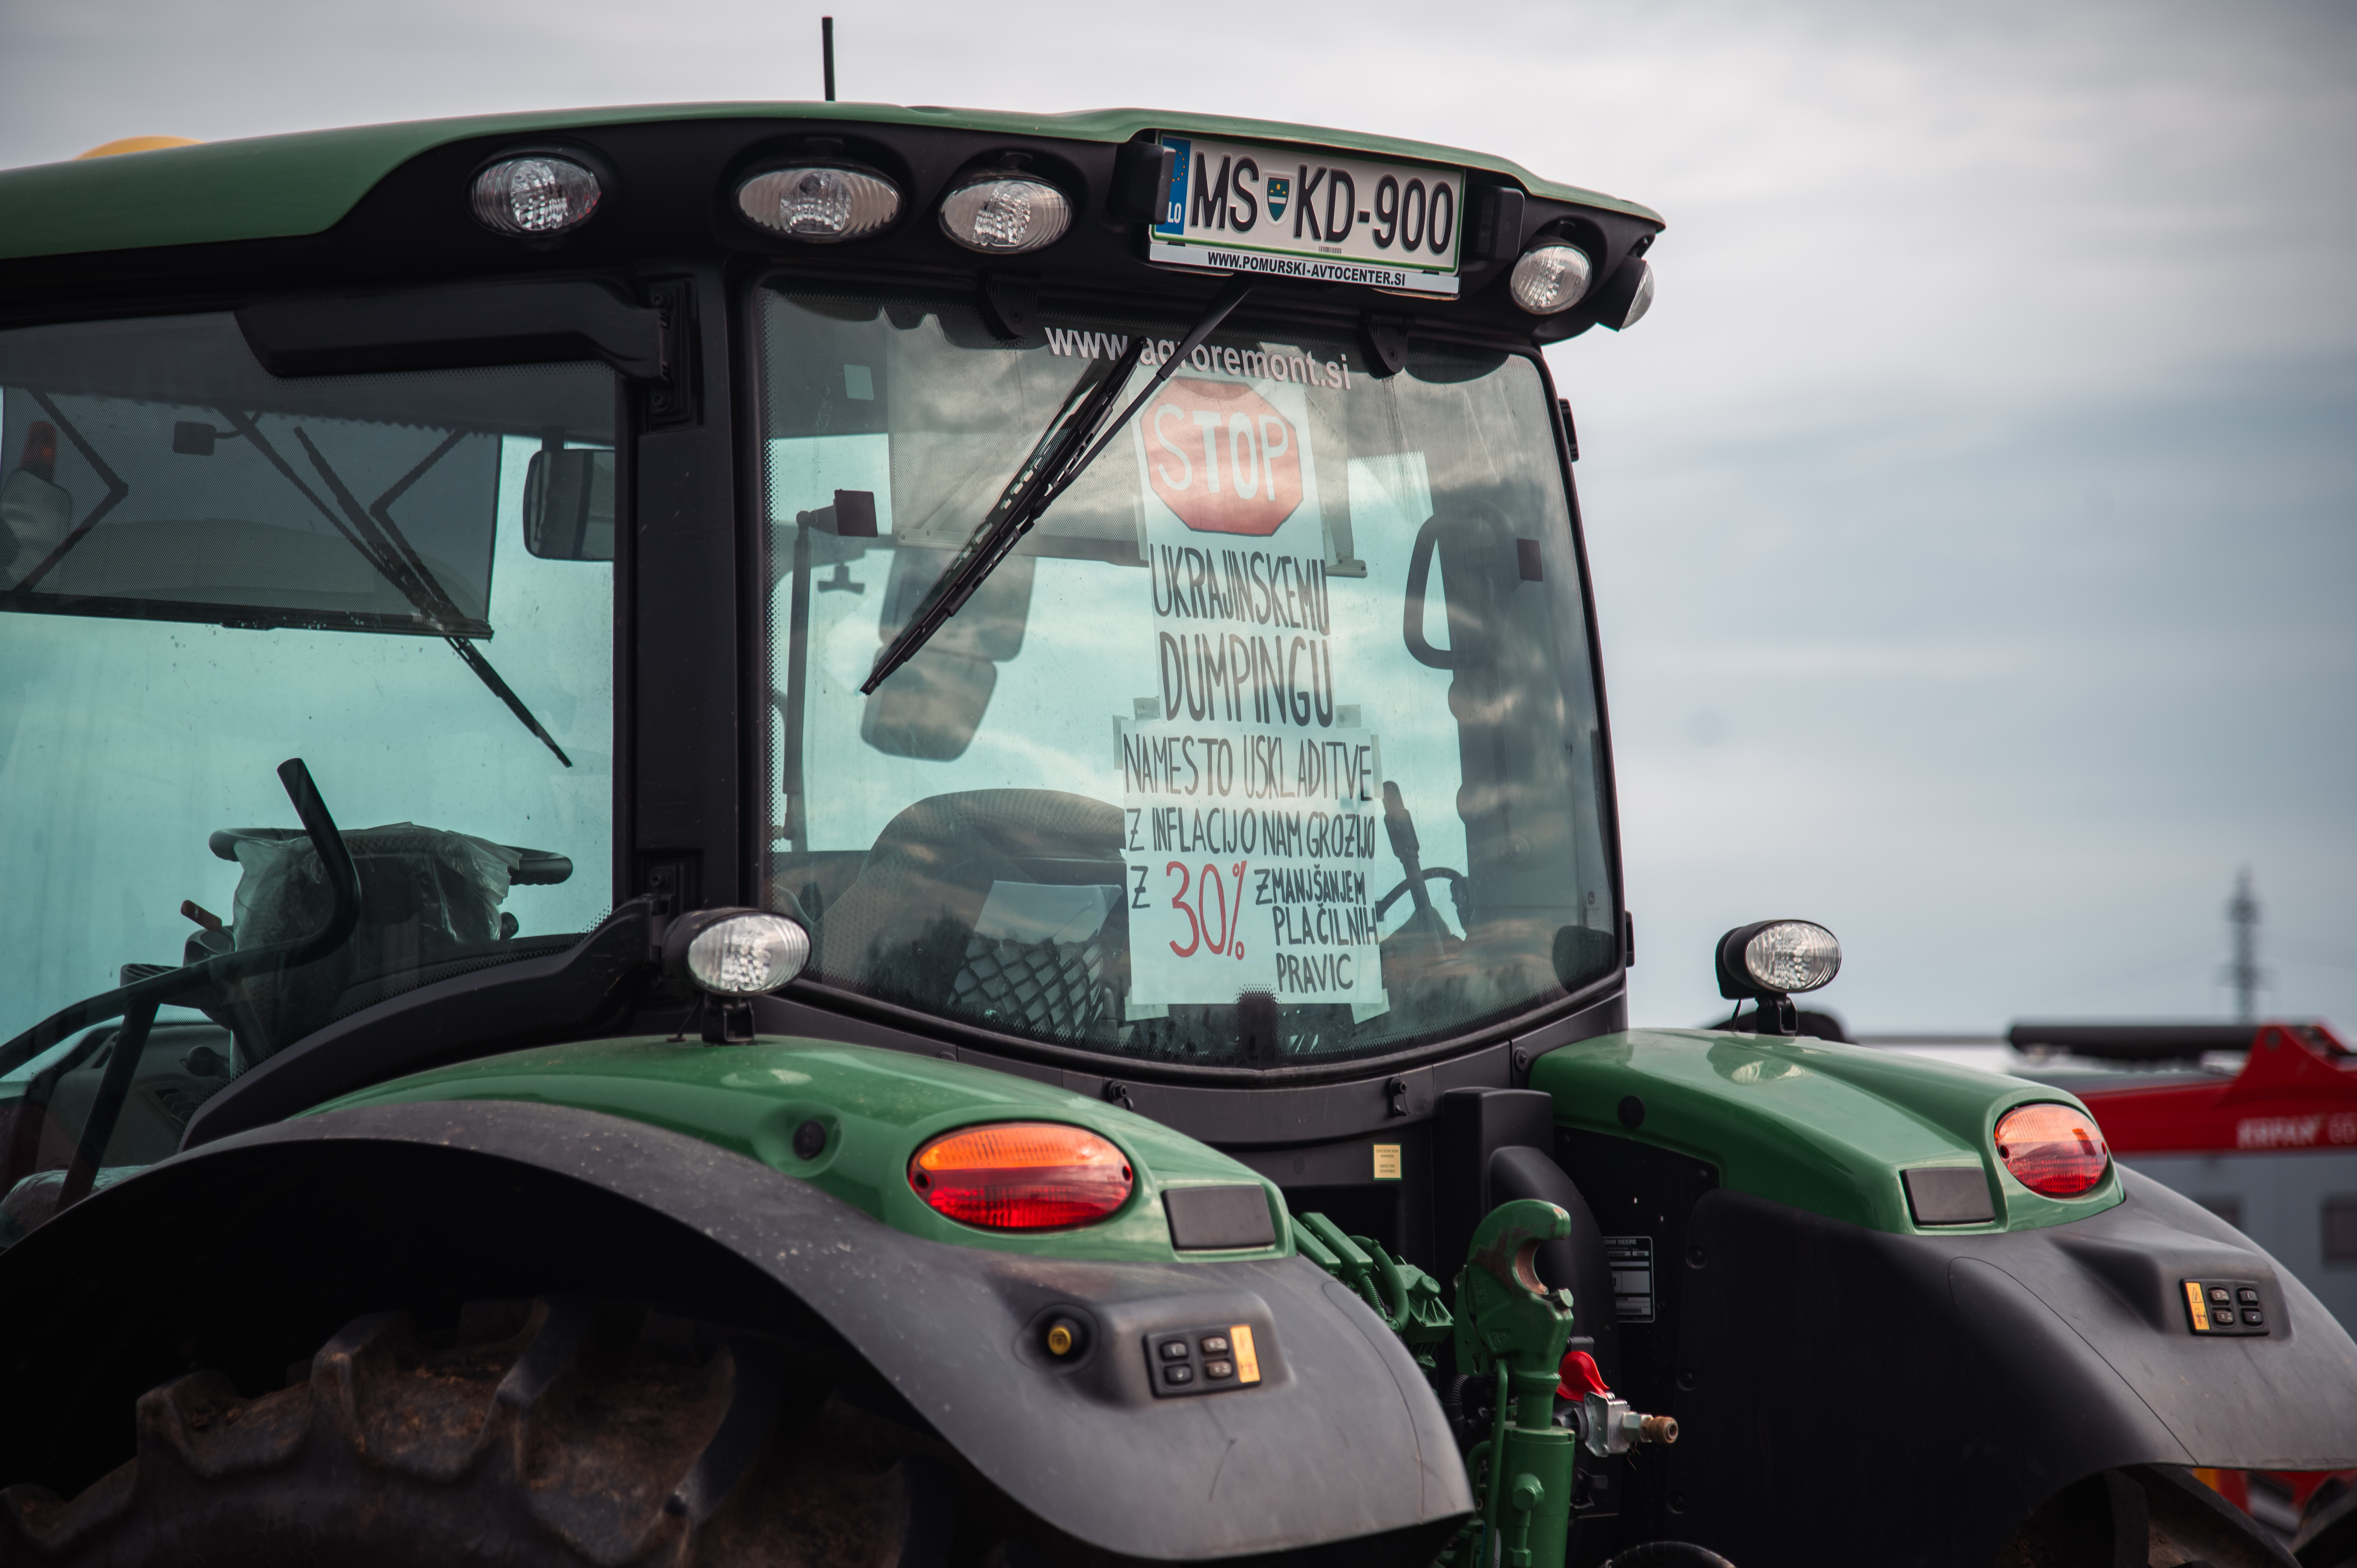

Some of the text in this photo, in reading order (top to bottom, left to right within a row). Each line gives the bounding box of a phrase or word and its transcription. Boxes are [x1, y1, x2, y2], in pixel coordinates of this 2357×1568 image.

[1166, 201, 1182, 224] LO
[1190, 151, 1454, 255] MS KD-900
[1208, 251, 1405, 286] WWW.POMURSKI-AVTOCENTER.SI
[1044, 327, 1351, 390] wwwagoremont.si
[1154, 403, 1288, 501] STOP
[1150, 544, 1330, 636] UKRAJINSKEMU
[1159, 631, 1333, 727] DUMPINGU
[1123, 733, 1373, 801] NAMESTO USKLADITVE
[1126, 807, 1375, 859] Z INFLACIJO NAM GROZIJO
[1130, 860, 1366, 960] Z 30% ZMANJŠANJEM
[1272, 902, 1379, 946] PLAČILNIH
[1276, 953, 1353, 993] PRAVIC
